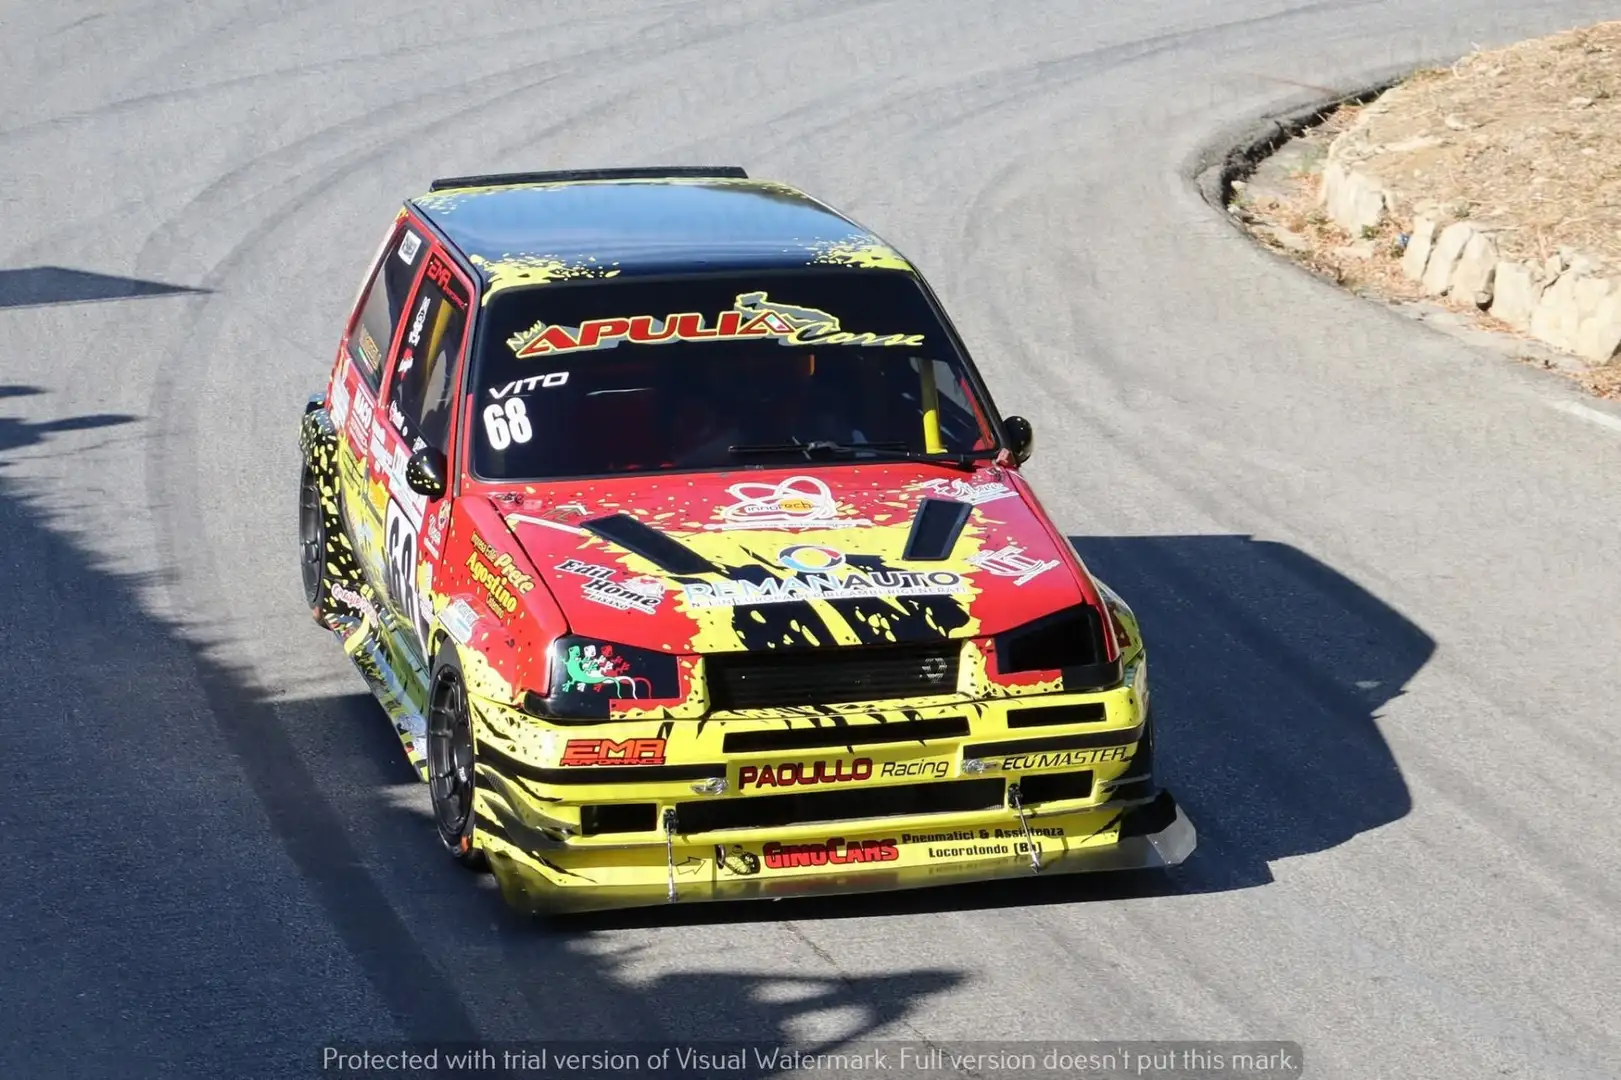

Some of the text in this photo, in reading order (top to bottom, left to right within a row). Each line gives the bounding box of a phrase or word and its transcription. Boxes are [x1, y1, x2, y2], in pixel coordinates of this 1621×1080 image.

[506, 321, 543, 350] New
[516, 311, 795, 359] APULIA
[489, 371, 569, 399] VITO
[483, 397, 533, 451] 68
[465, 550, 518, 613] Agostino
[493, 552, 535, 595] Prete
[559, 560, 615, 579] Edil
[585, 579, 660, 607] Home
[685, 571, 960, 601] REMANAUTO
[563, 738, 666, 760] EMA
[1001, 746, 1128, 771] ECUMASTER
[881, 759, 949, 778] Racing
[902, 829, 974, 844] Pneumatici
[979, 828, 989, 839] &
[928, 843, 1009, 858] Locorotondo
